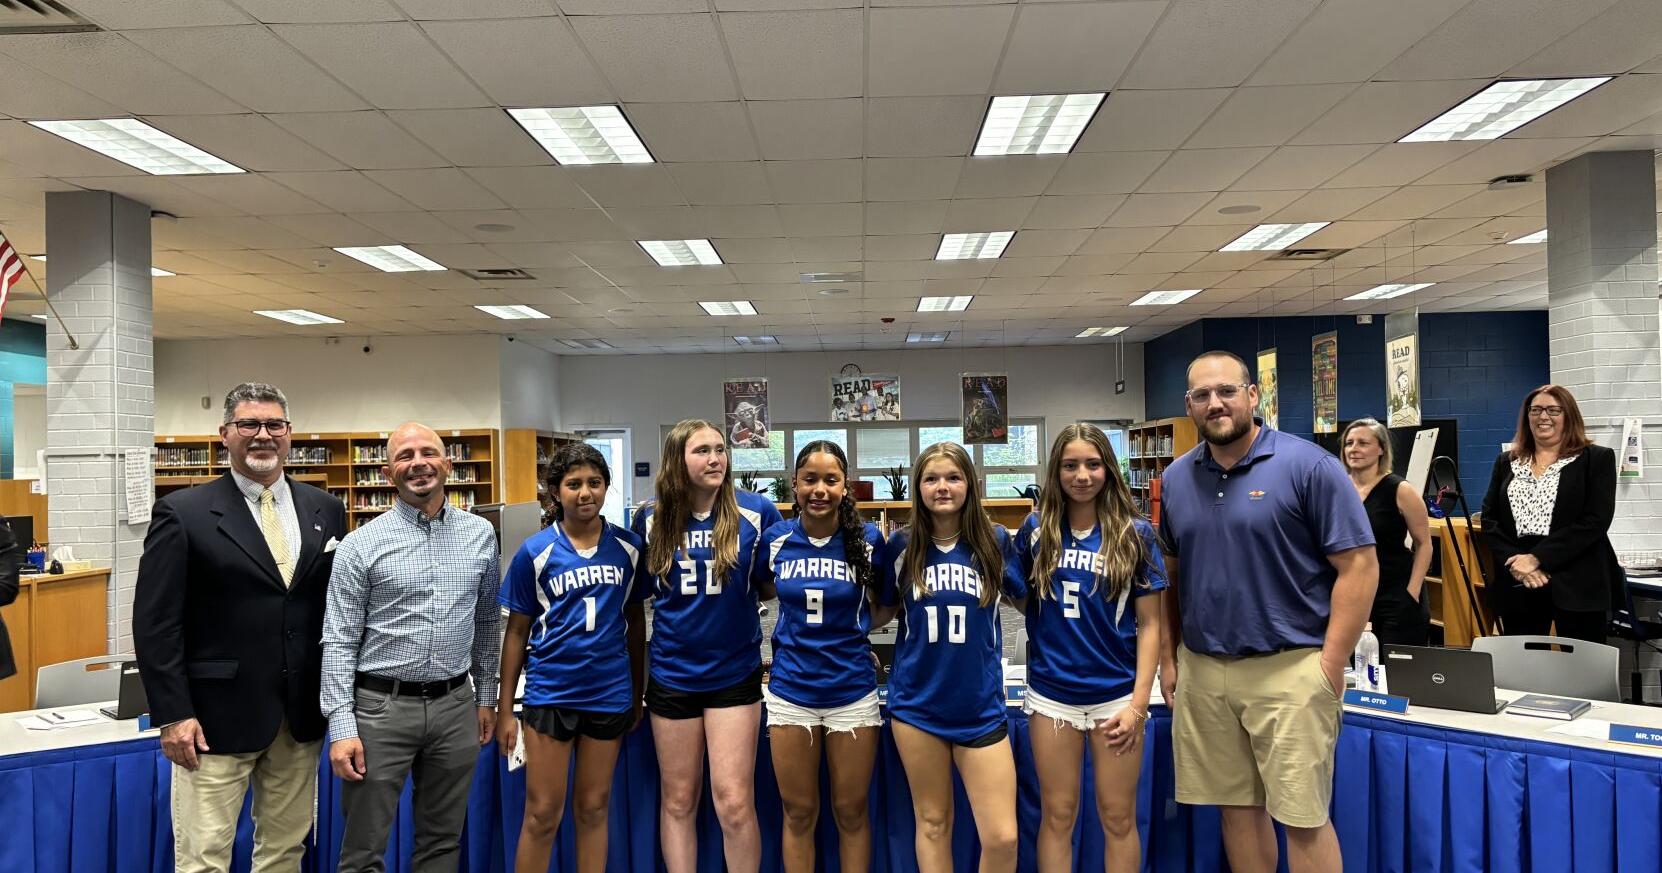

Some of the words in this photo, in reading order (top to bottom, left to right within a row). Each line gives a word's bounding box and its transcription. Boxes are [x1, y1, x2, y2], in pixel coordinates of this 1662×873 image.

[1392, 346, 1410, 360] READ
[725, 383, 767, 393] READ
[833, 379, 871, 396] READ
[549, 564, 624, 597] WARREN
[677, 560, 722, 595] 20
[780, 557, 856, 583] WARREN
[582, 596, 596, 632] 1
[804, 588, 824, 624] 9
[1061, 580, 1081, 618] 5
[924, 605, 967, 644] 10
[1635, 732, 1649, 740] MR.
